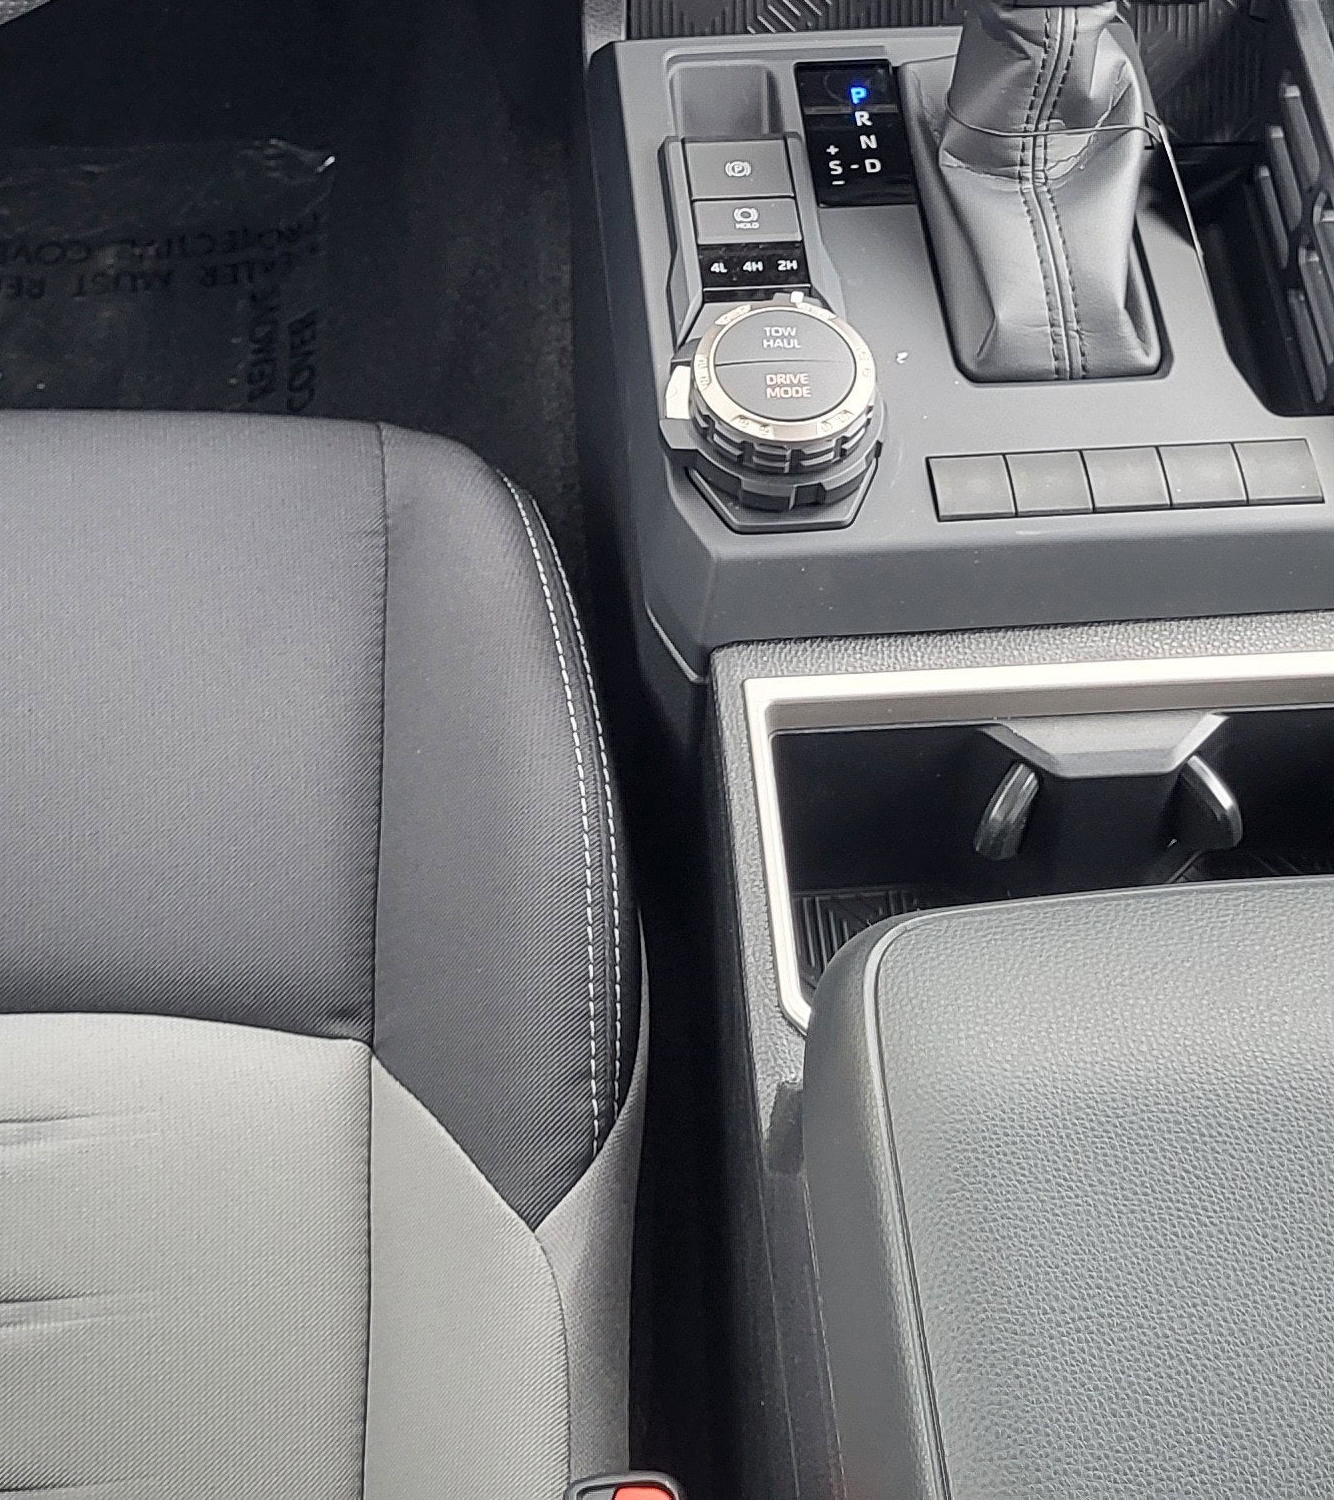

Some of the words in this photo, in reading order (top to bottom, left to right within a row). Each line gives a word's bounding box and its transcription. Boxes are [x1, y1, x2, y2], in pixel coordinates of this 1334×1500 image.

[850, 86, 867, 105] P
[855, 110, 873, 127] R
[859, 134, 878, 149] N
[828, 159, 843, 175] S
[864, 158, 882, 173] D
[710, 263, 728, 273] 4L
[742, 261, 763, 272] 4H
[777, 259, 798, 271] 2H
[763, 326, 797, 337] TOW
[762, 338, 802, 349] HAUL
[766, 373, 810, 386] DRIVE
[766, 386, 812, 399] MODE
